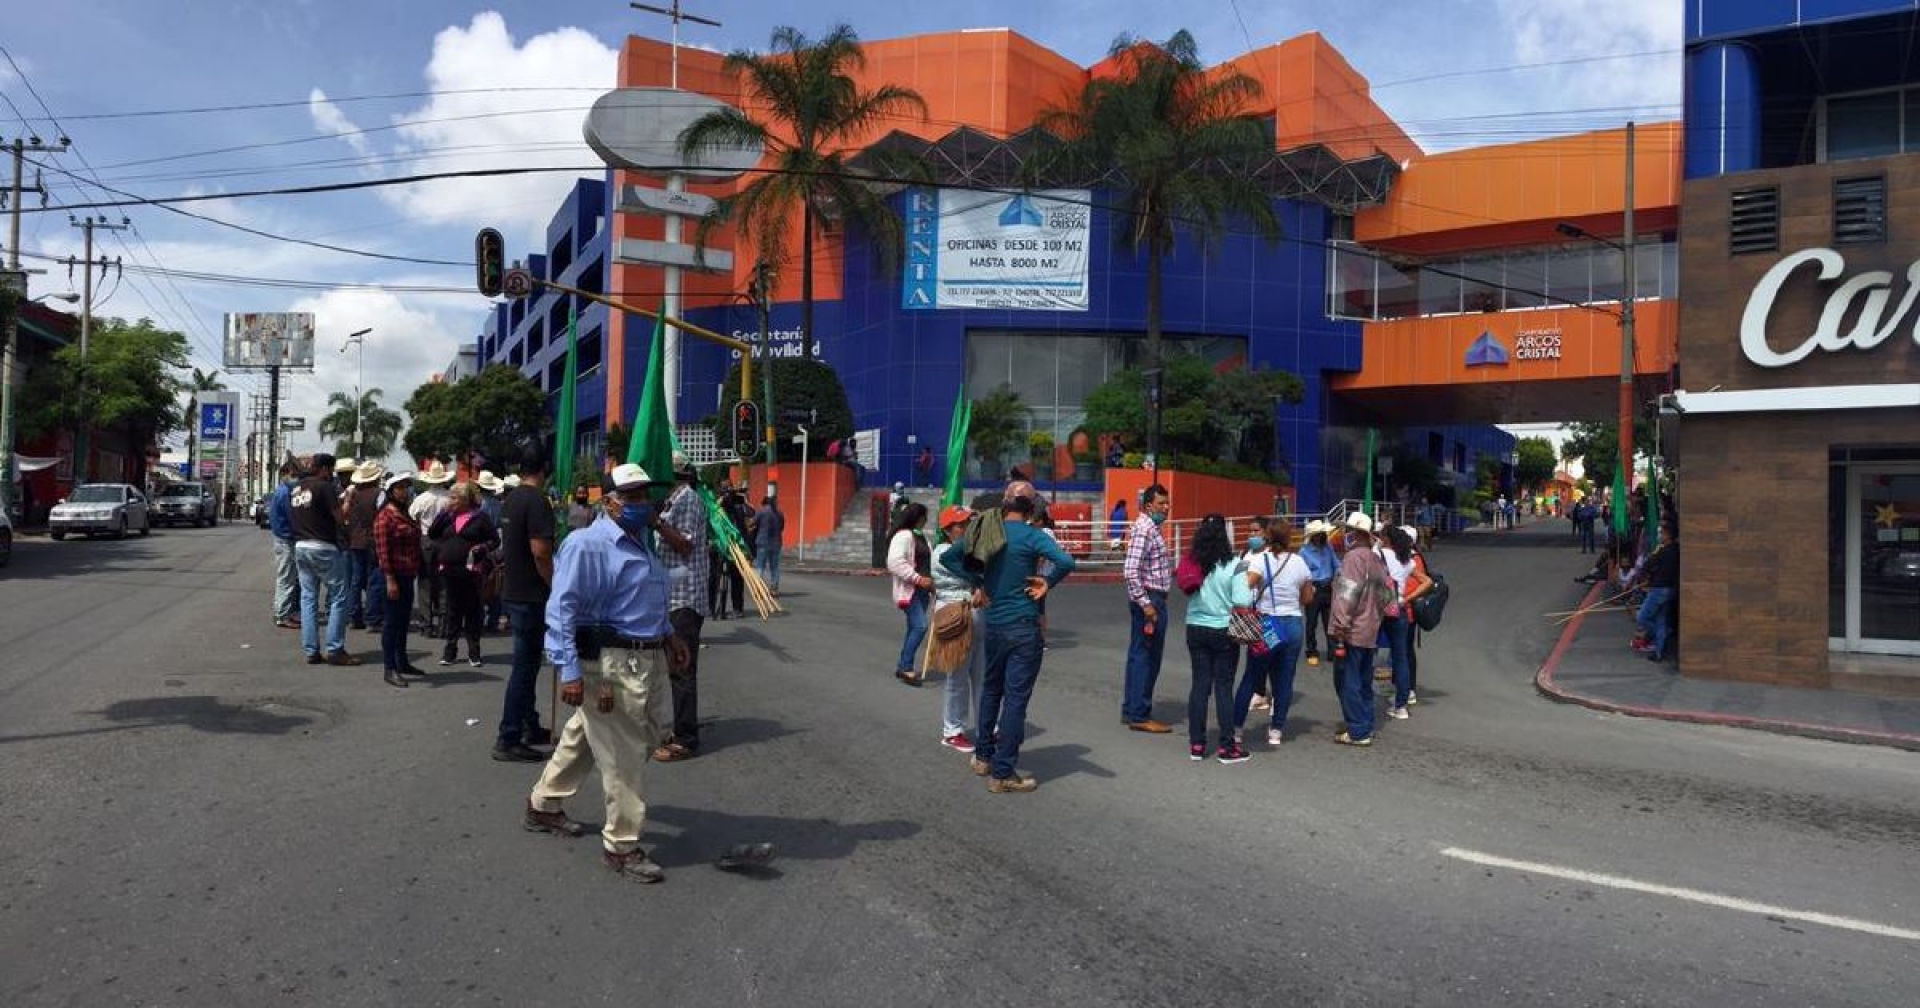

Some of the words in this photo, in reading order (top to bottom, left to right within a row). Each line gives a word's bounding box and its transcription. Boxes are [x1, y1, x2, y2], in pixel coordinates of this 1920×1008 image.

[1050, 219, 1086, 229] CRISTAL
[909, 194, 934, 305] RENTA
[948, 239, 998, 251] OFICINAS
[1004, 239, 1038, 251] DESDE
[1042, 240, 1062, 251] 100
[1064, 241, 1083, 252] M2
[969, 258, 1005, 268] HASTA
[1010, 258, 1037, 268] 8000
[1040, 258, 1059, 269] M2
[1516, 336, 1561, 347] ARCOS
[1516, 347, 1562, 359] CRISTAL
